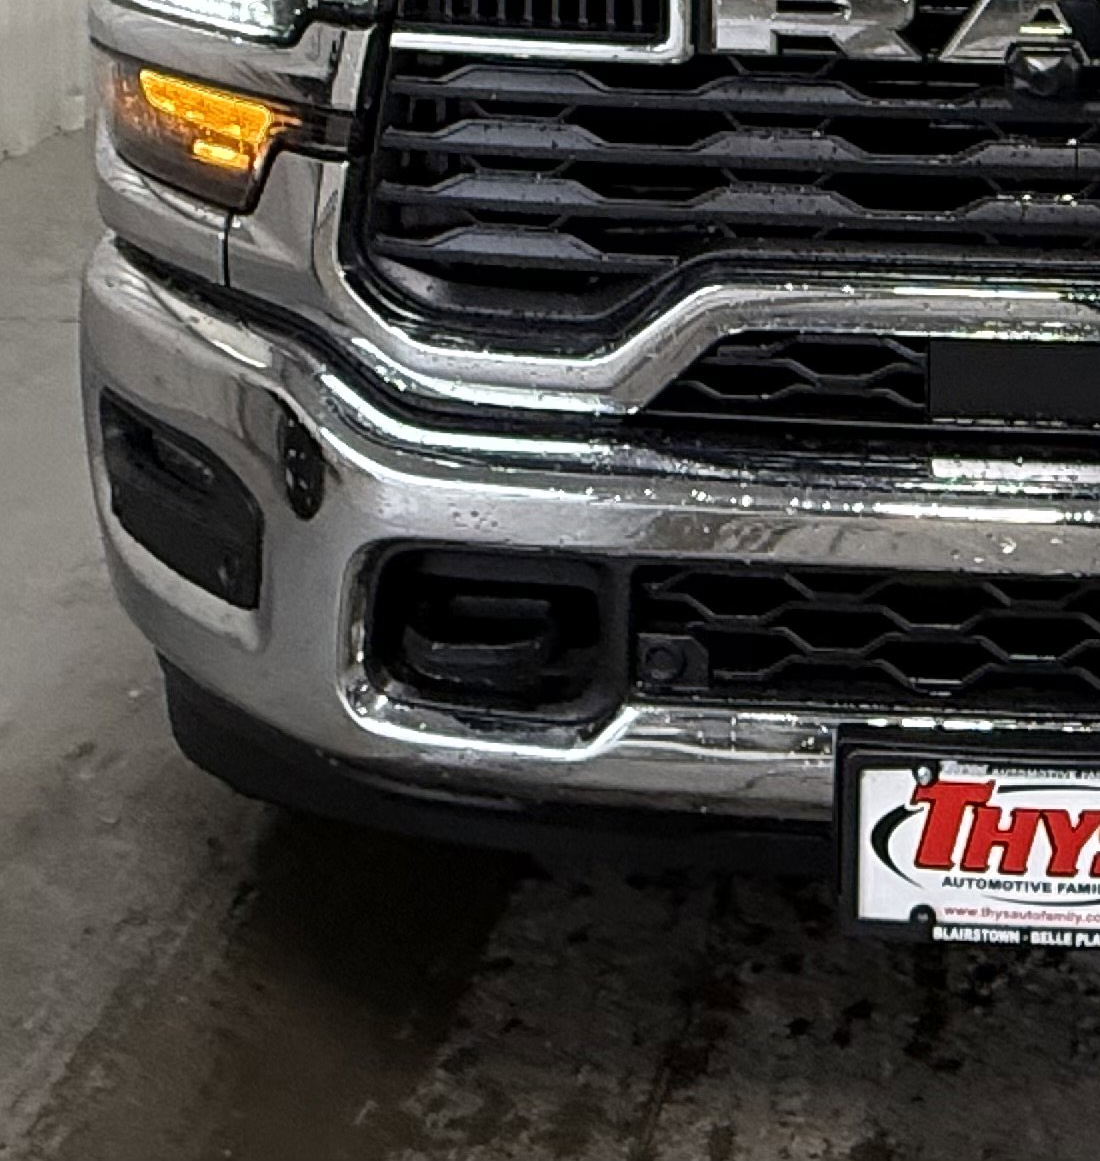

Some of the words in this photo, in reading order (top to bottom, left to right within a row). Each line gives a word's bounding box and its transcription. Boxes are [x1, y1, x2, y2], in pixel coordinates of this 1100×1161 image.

[942, 876, 1053, 893] AUTOMOTIVE
[932, 926, 1020, 944] BLAIRSTOWN
[1030, 930, 1073, 946] BELLE
